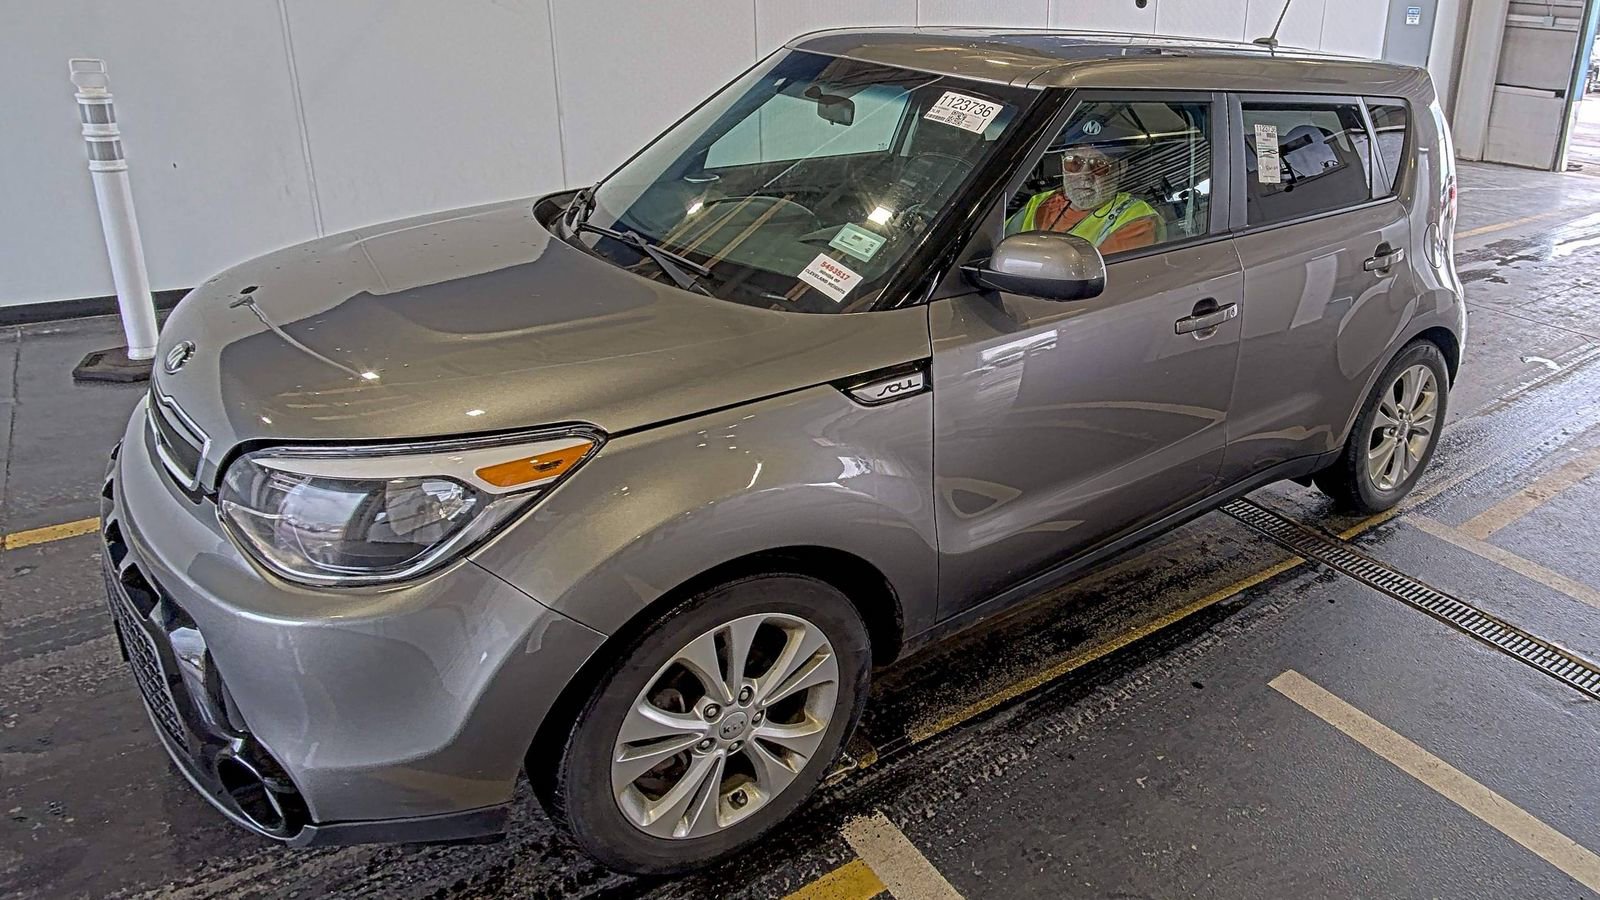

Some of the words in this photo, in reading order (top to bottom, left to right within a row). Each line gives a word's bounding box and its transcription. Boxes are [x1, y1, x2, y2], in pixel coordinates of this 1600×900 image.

[940, 95, 994, 117] 1123736
[805, 268, 829, 284] CLEVELAND
[828, 281, 846, 295] HEIGHTS
[820, 261, 850, 281] 5493517
[877, 379, 920, 397] SOUL
